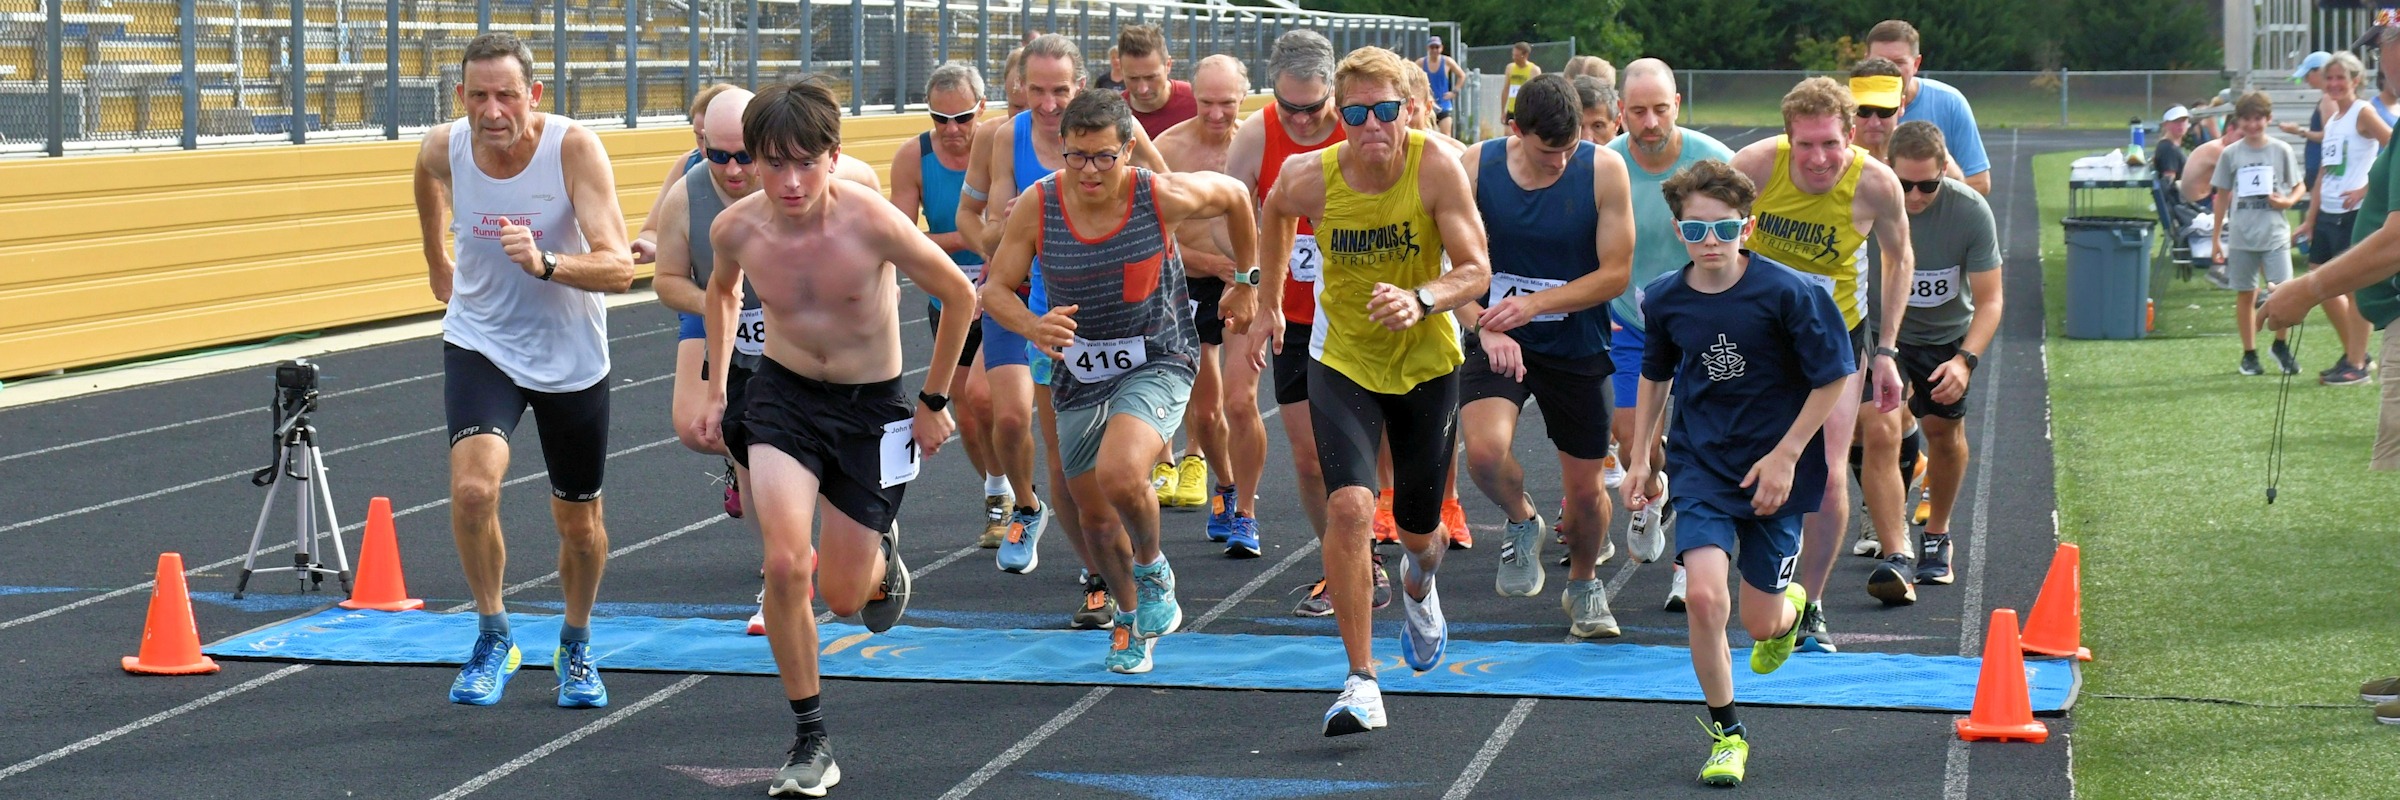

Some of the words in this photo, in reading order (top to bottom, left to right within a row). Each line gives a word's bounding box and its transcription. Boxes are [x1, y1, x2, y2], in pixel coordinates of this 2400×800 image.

[2251, 174, 2261, 187] 4
[481, 216, 531, 226] Annolis
[1757, 211, 1825, 244] ANNAPOLIS
[473, 226, 502, 237] Runni
[1331, 223, 1399, 253] ANNAPOLIS
[1756, 232, 1820, 256] STRIDERS
[1331, 250, 1403, 266] STRIDERS
[1910, 279, 1948, 297] 88
[1076, 350, 1132, 372] 416
[892, 426, 907, 434] John
[1780, 557, 1795, 583] 4
